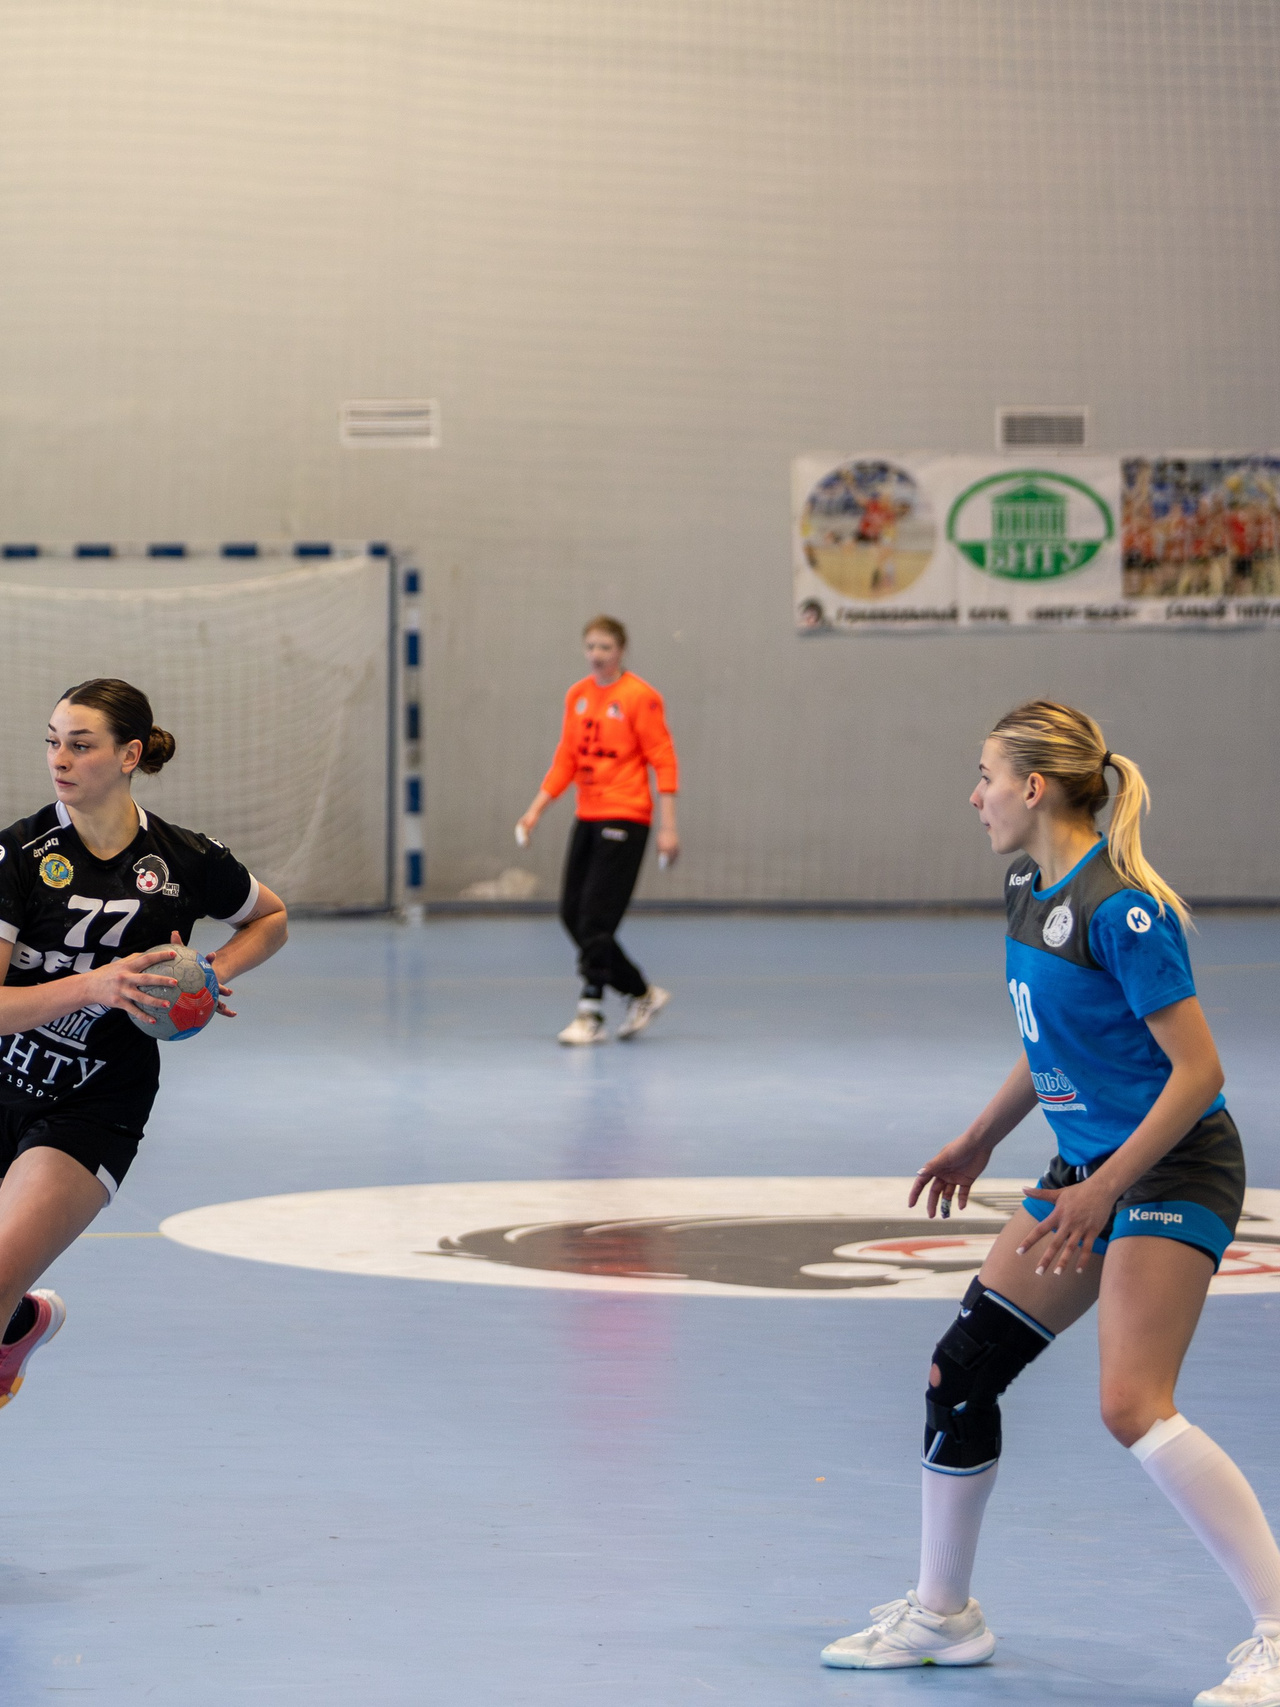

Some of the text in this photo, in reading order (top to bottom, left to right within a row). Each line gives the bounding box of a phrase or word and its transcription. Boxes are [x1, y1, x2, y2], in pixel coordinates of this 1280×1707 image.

[64, 894, 140, 948] 77
[1008, 978, 1040, 1043] 10
[1129, 1208, 1183, 1225] Kempa
